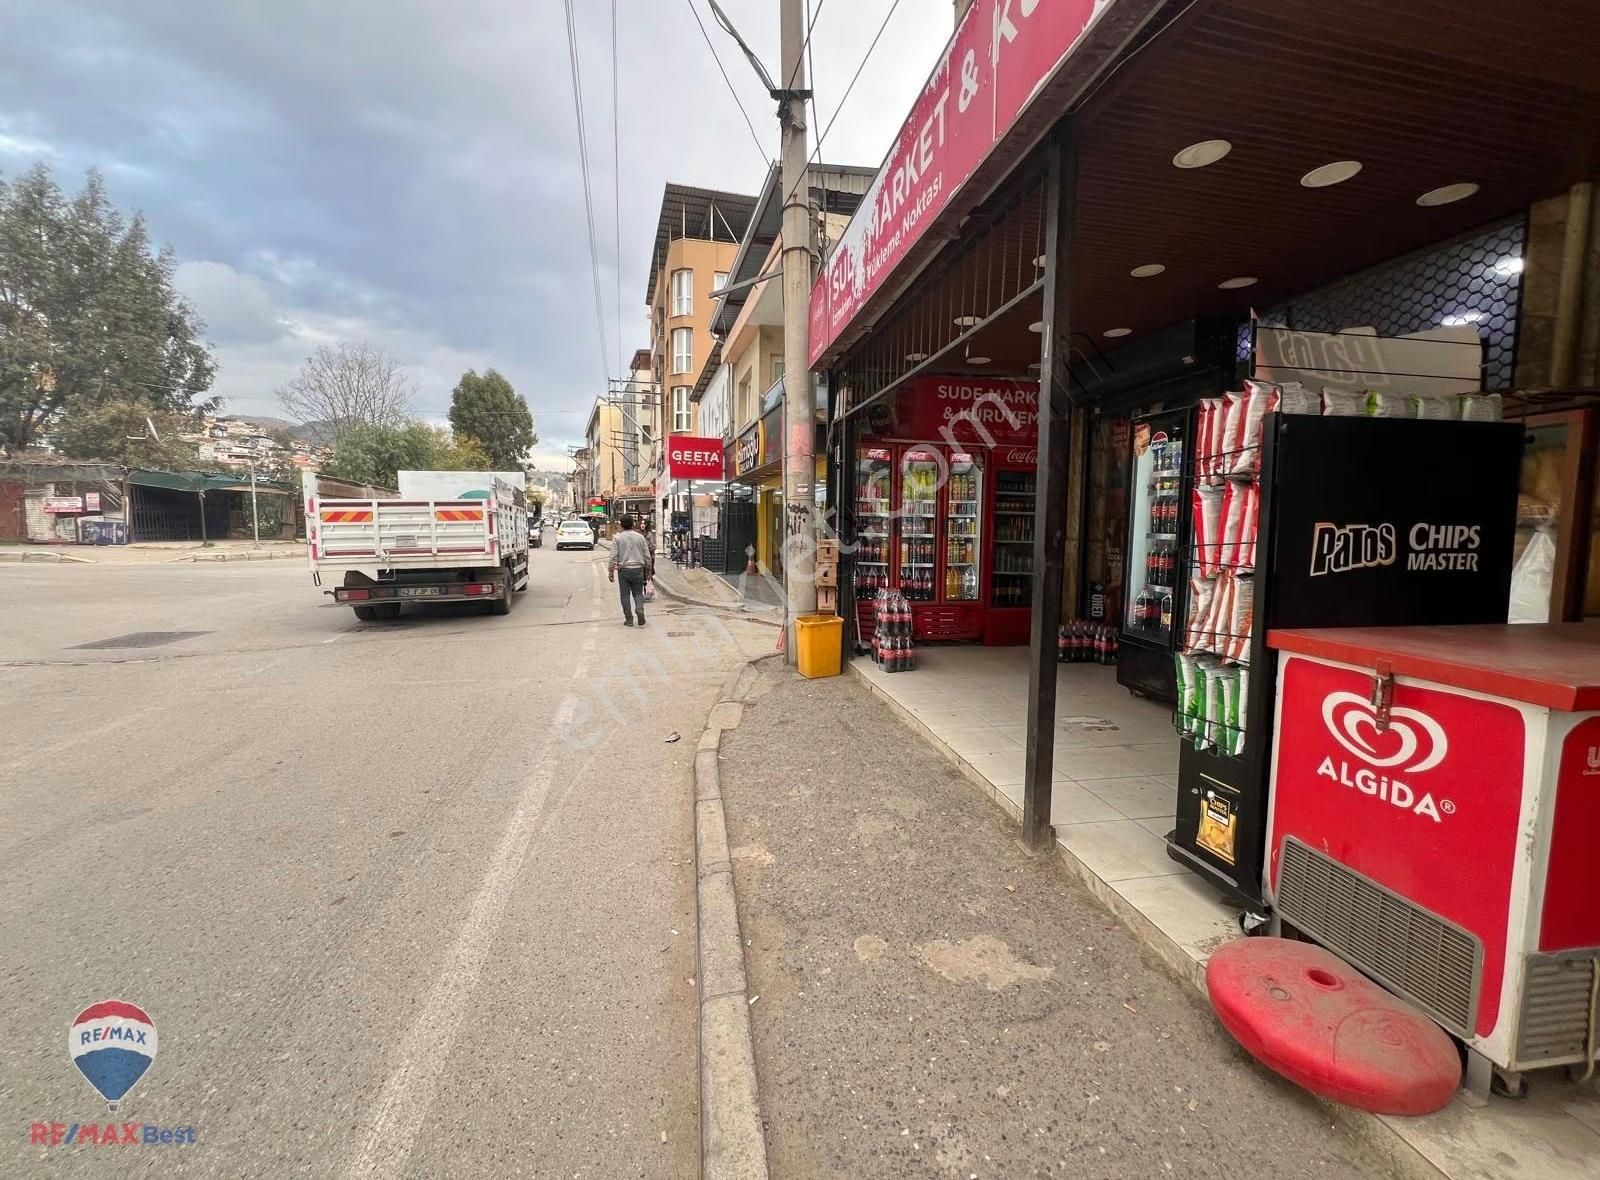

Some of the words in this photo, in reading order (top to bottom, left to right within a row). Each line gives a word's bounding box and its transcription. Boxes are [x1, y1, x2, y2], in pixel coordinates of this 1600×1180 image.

[958, 48, 979, 113] &
[938, 385, 983, 401] SUDE
[988, 388, 1040, 405] MARK
[943, 406, 954, 420] &
[672, 450, 720, 463] GEETA
[1408, 523, 1481, 551] CHIPS
[1407, 553, 1478, 572] MASTER
